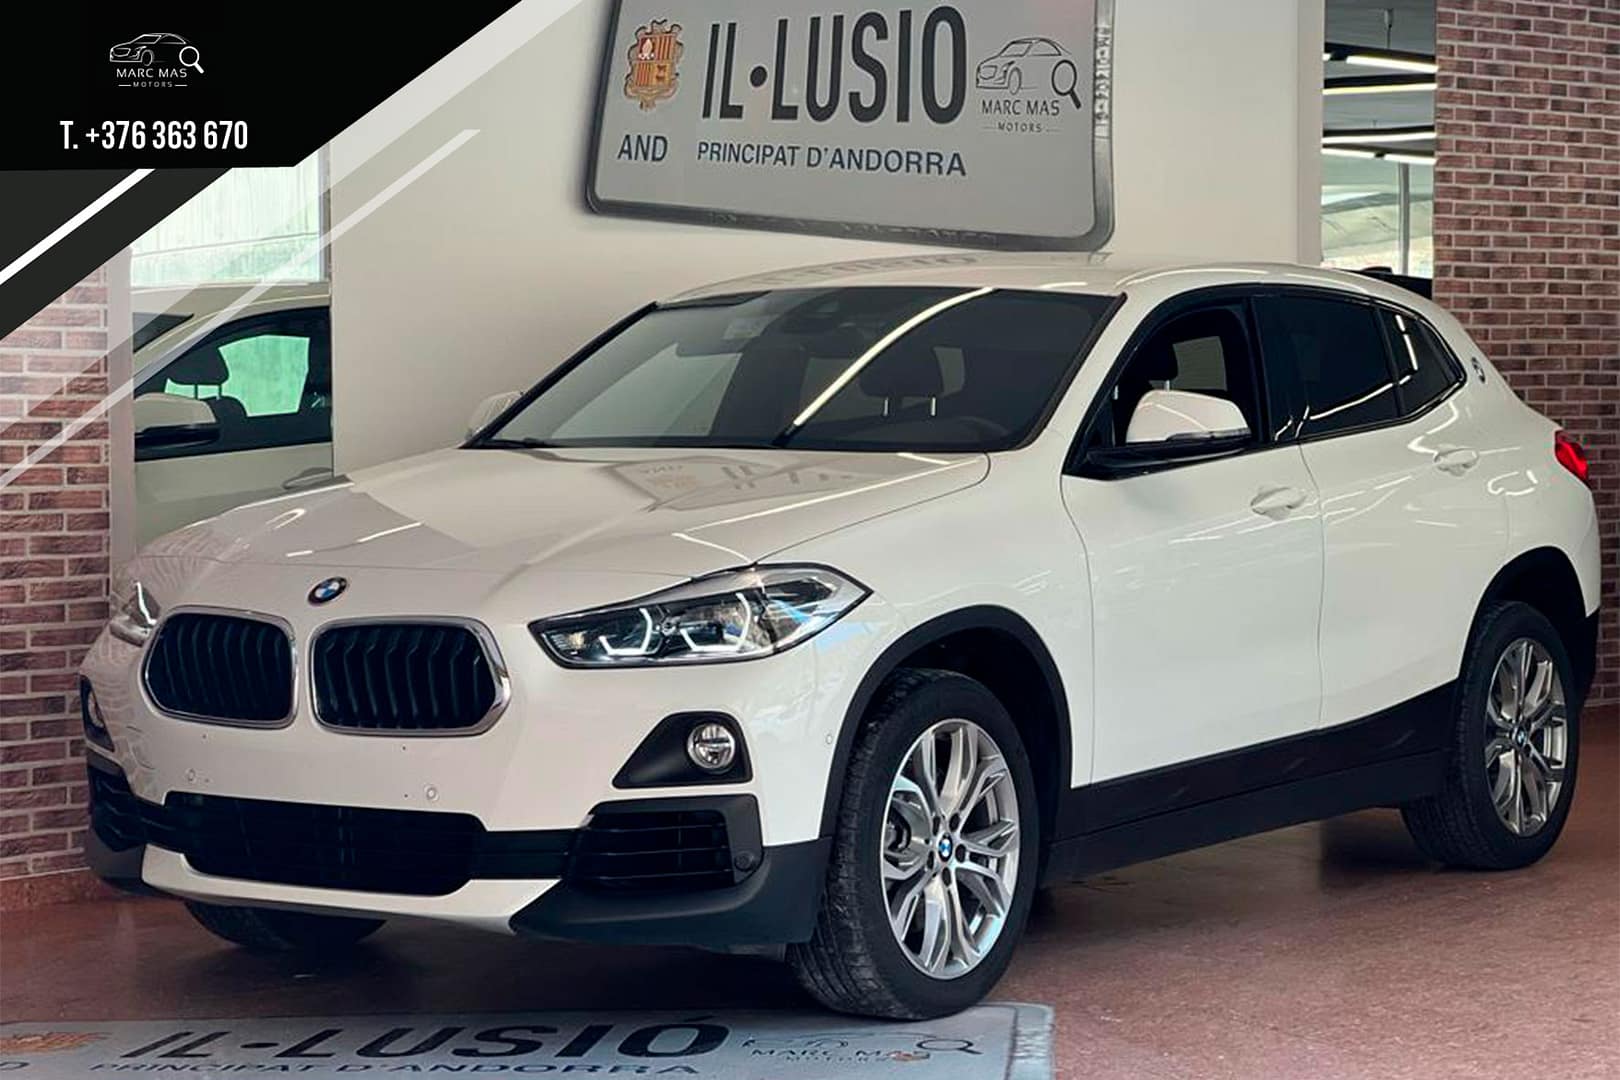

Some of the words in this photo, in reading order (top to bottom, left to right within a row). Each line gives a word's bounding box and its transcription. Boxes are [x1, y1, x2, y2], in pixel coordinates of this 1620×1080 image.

[981, 99, 1021, 116] MARC
[1026, 100, 1060, 117] MAS
[997, 121, 1042, 133] MOTORS
[617, 134, 669, 162] AND
[697, 142, 800, 167] PRINCIPAT
[806, 147, 967, 176] D'ANDORRA
[89, 1063, 318, 1073] PRINCIPAT
[335, 1064, 700, 1074] D'ANDORRA
